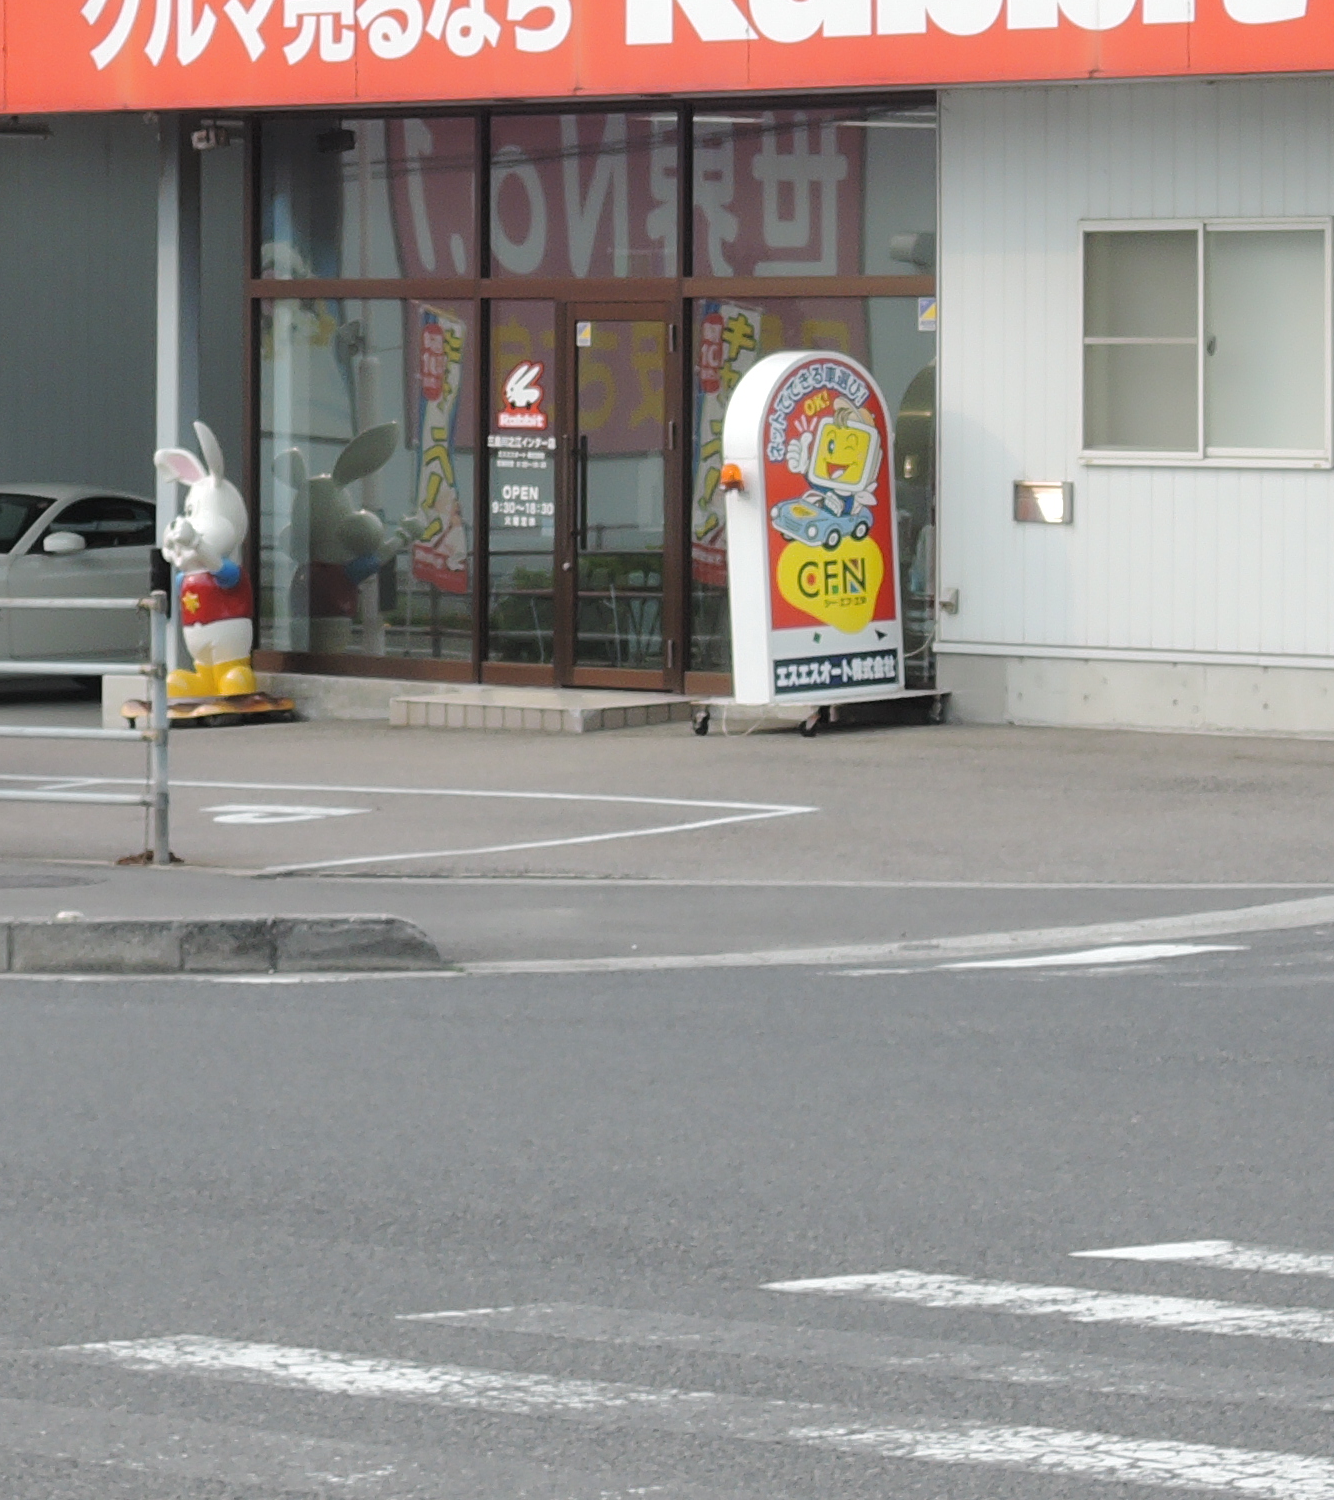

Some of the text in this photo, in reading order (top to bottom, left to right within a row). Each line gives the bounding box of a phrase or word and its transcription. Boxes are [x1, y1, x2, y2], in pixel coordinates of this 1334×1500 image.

[803, 390, 830, 417] OK!
[502, 484, 539, 501] OPEN
[797, 558, 867, 598] CFN
